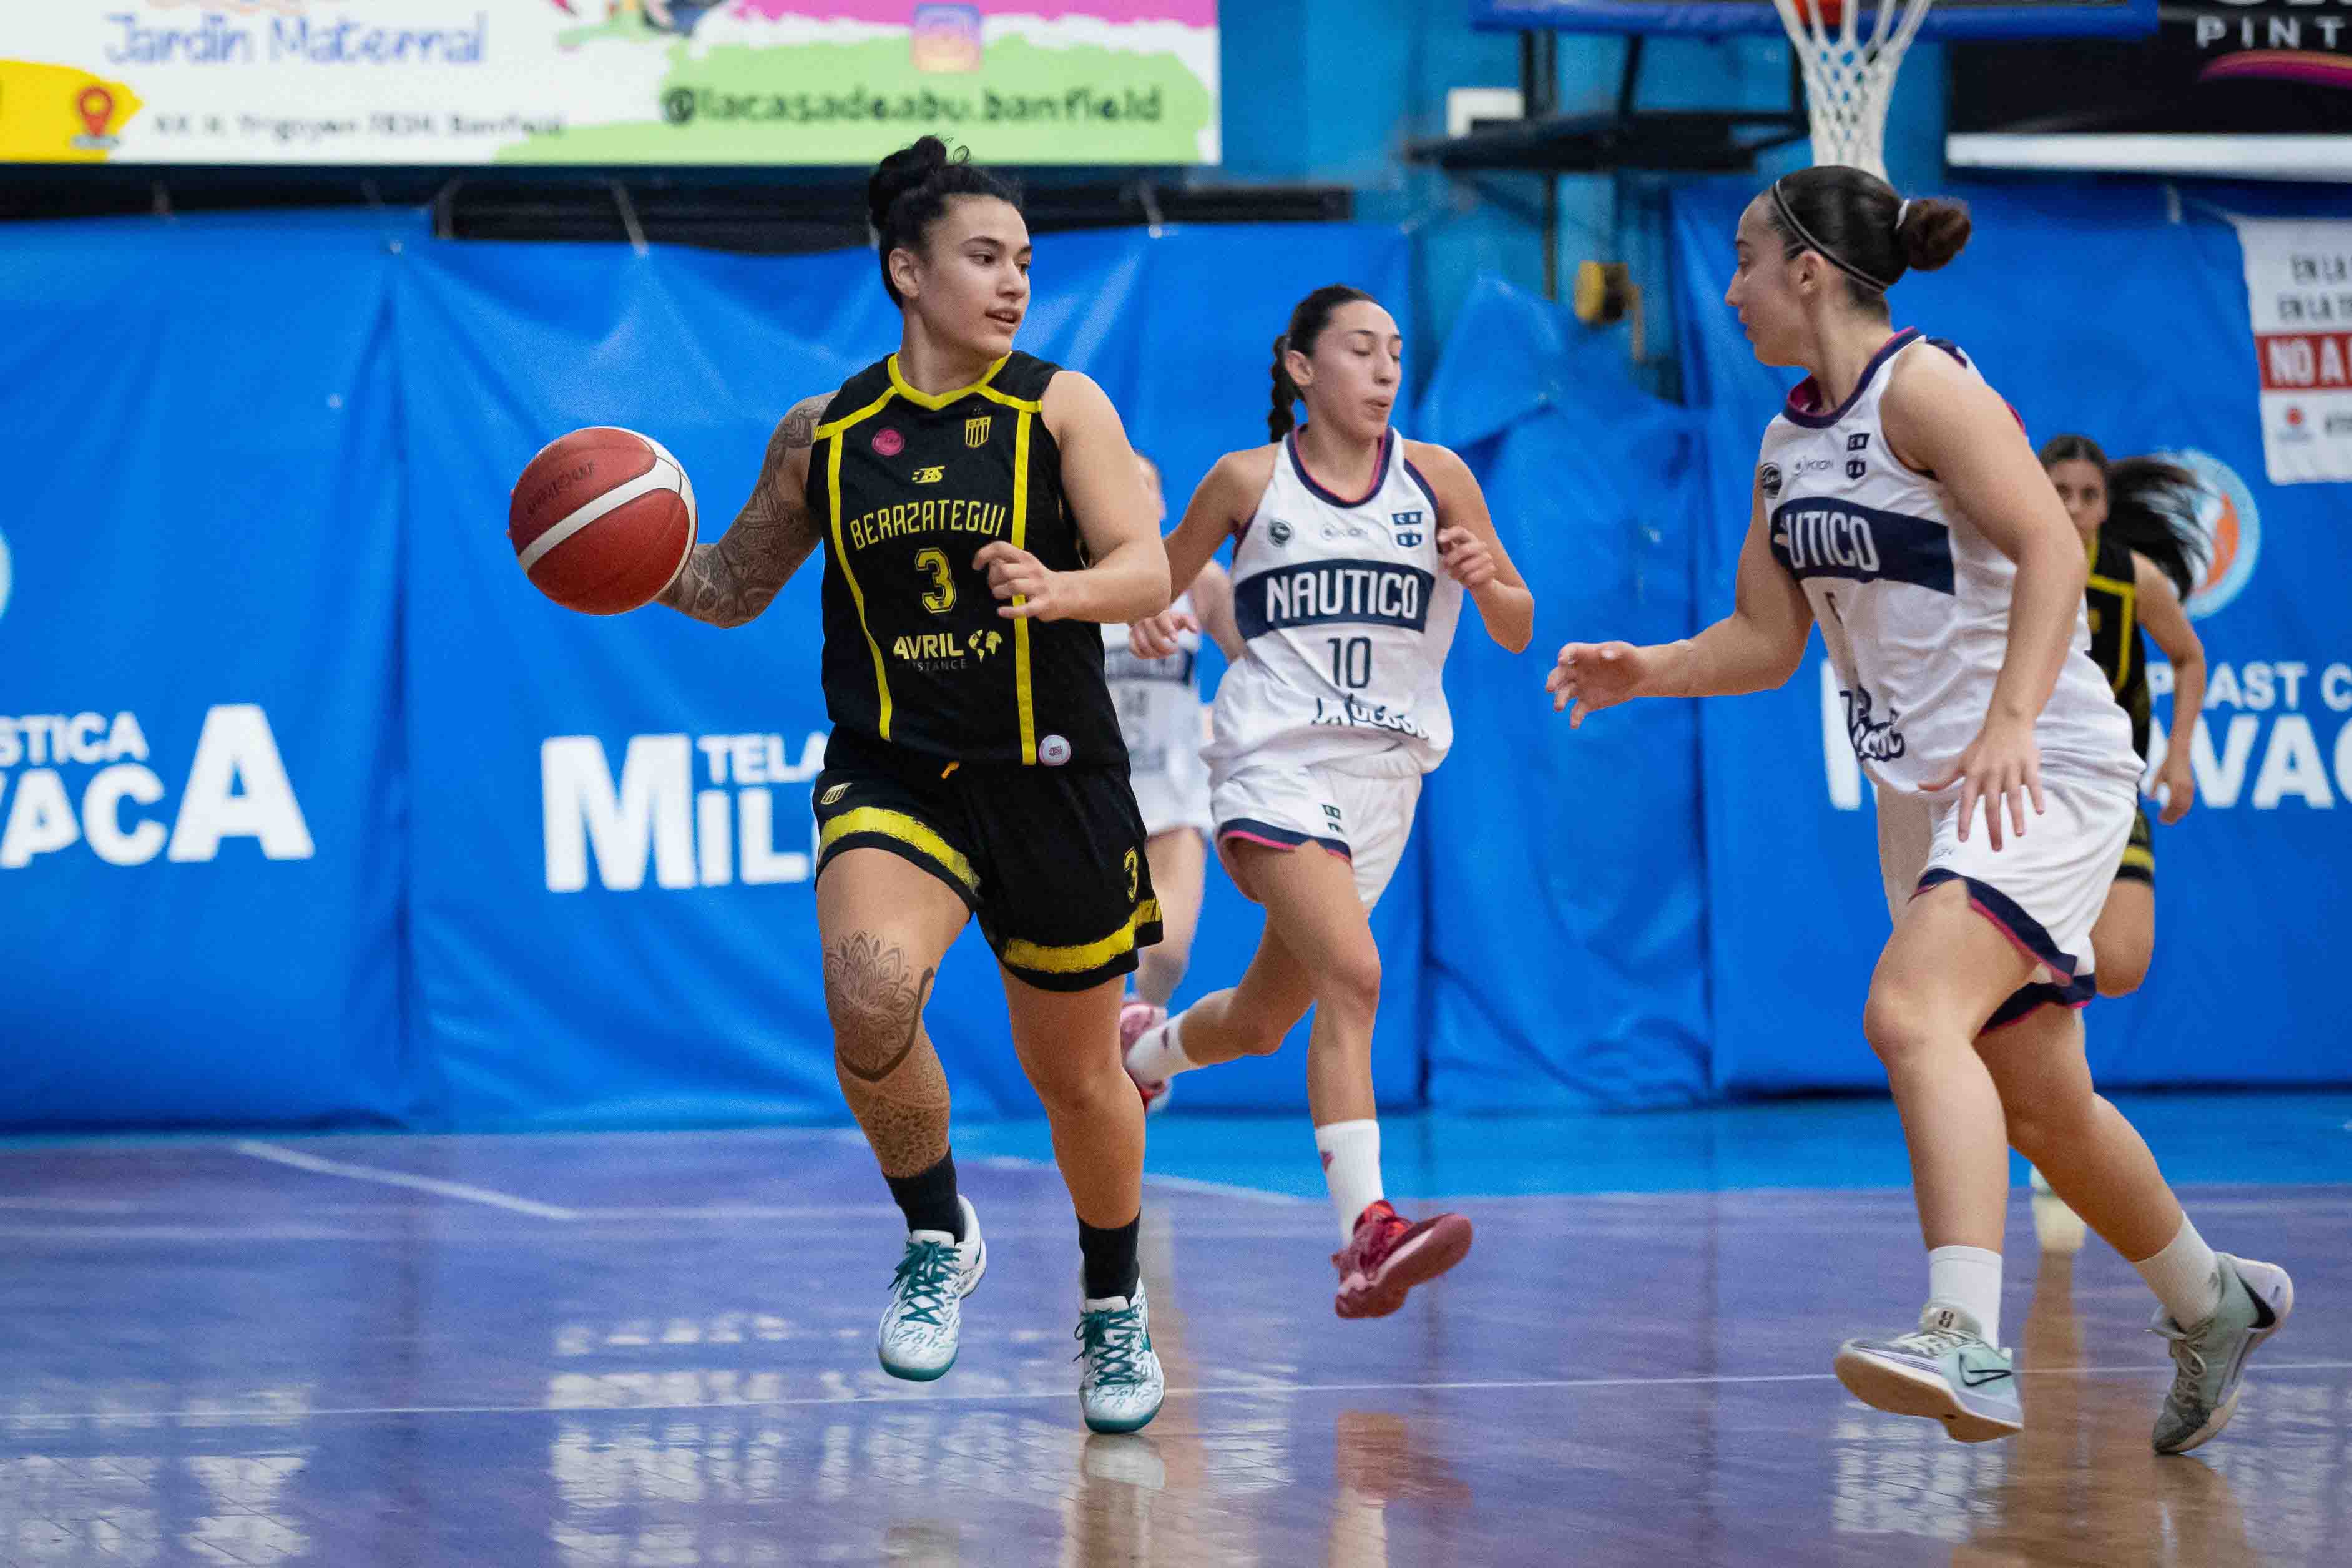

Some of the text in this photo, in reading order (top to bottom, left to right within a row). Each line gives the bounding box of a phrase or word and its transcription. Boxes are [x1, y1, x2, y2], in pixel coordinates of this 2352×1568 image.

[270, 10, 488, 64] Maternal
[2196, 16, 2346, 49] PINT
[662, 87, 1163, 126] @lacasadeabu.banfield
[2320, 336, 2352, 386] A
[850, 499, 1006, 550] BERAZATEGUI
[914, 547, 957, 614] 3
[1266, 569, 1419, 621] NAUTICO
[893, 633, 964, 660] AVRIL
[1328, 637, 1373, 689] 10
[2144, 660, 2309, 711] PAST
[0, 704, 315, 869] ACA
[1123, 847, 1138, 901] 3
